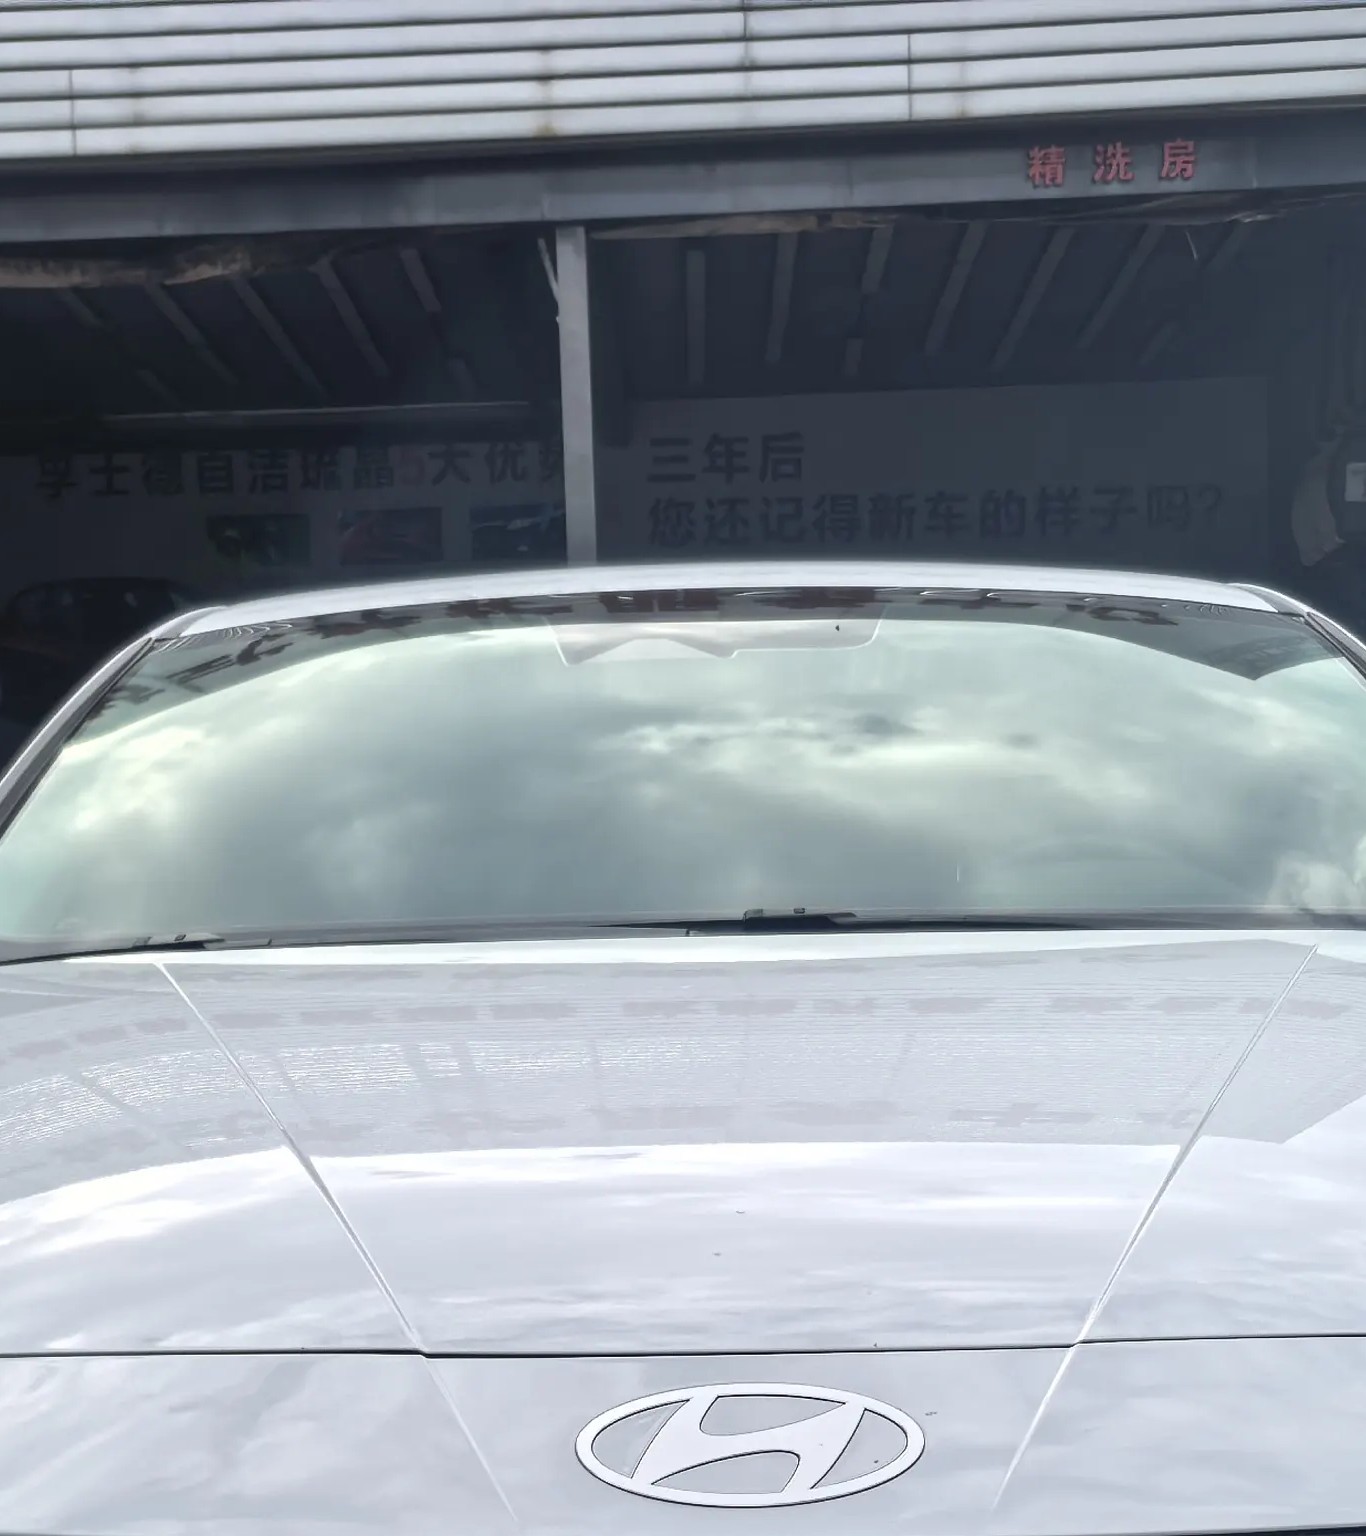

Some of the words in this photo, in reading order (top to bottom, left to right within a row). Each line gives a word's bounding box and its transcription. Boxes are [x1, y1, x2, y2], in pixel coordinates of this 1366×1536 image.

[1026, 138, 1198, 187] 精洗房
[647, 432, 806, 485] 三年后
